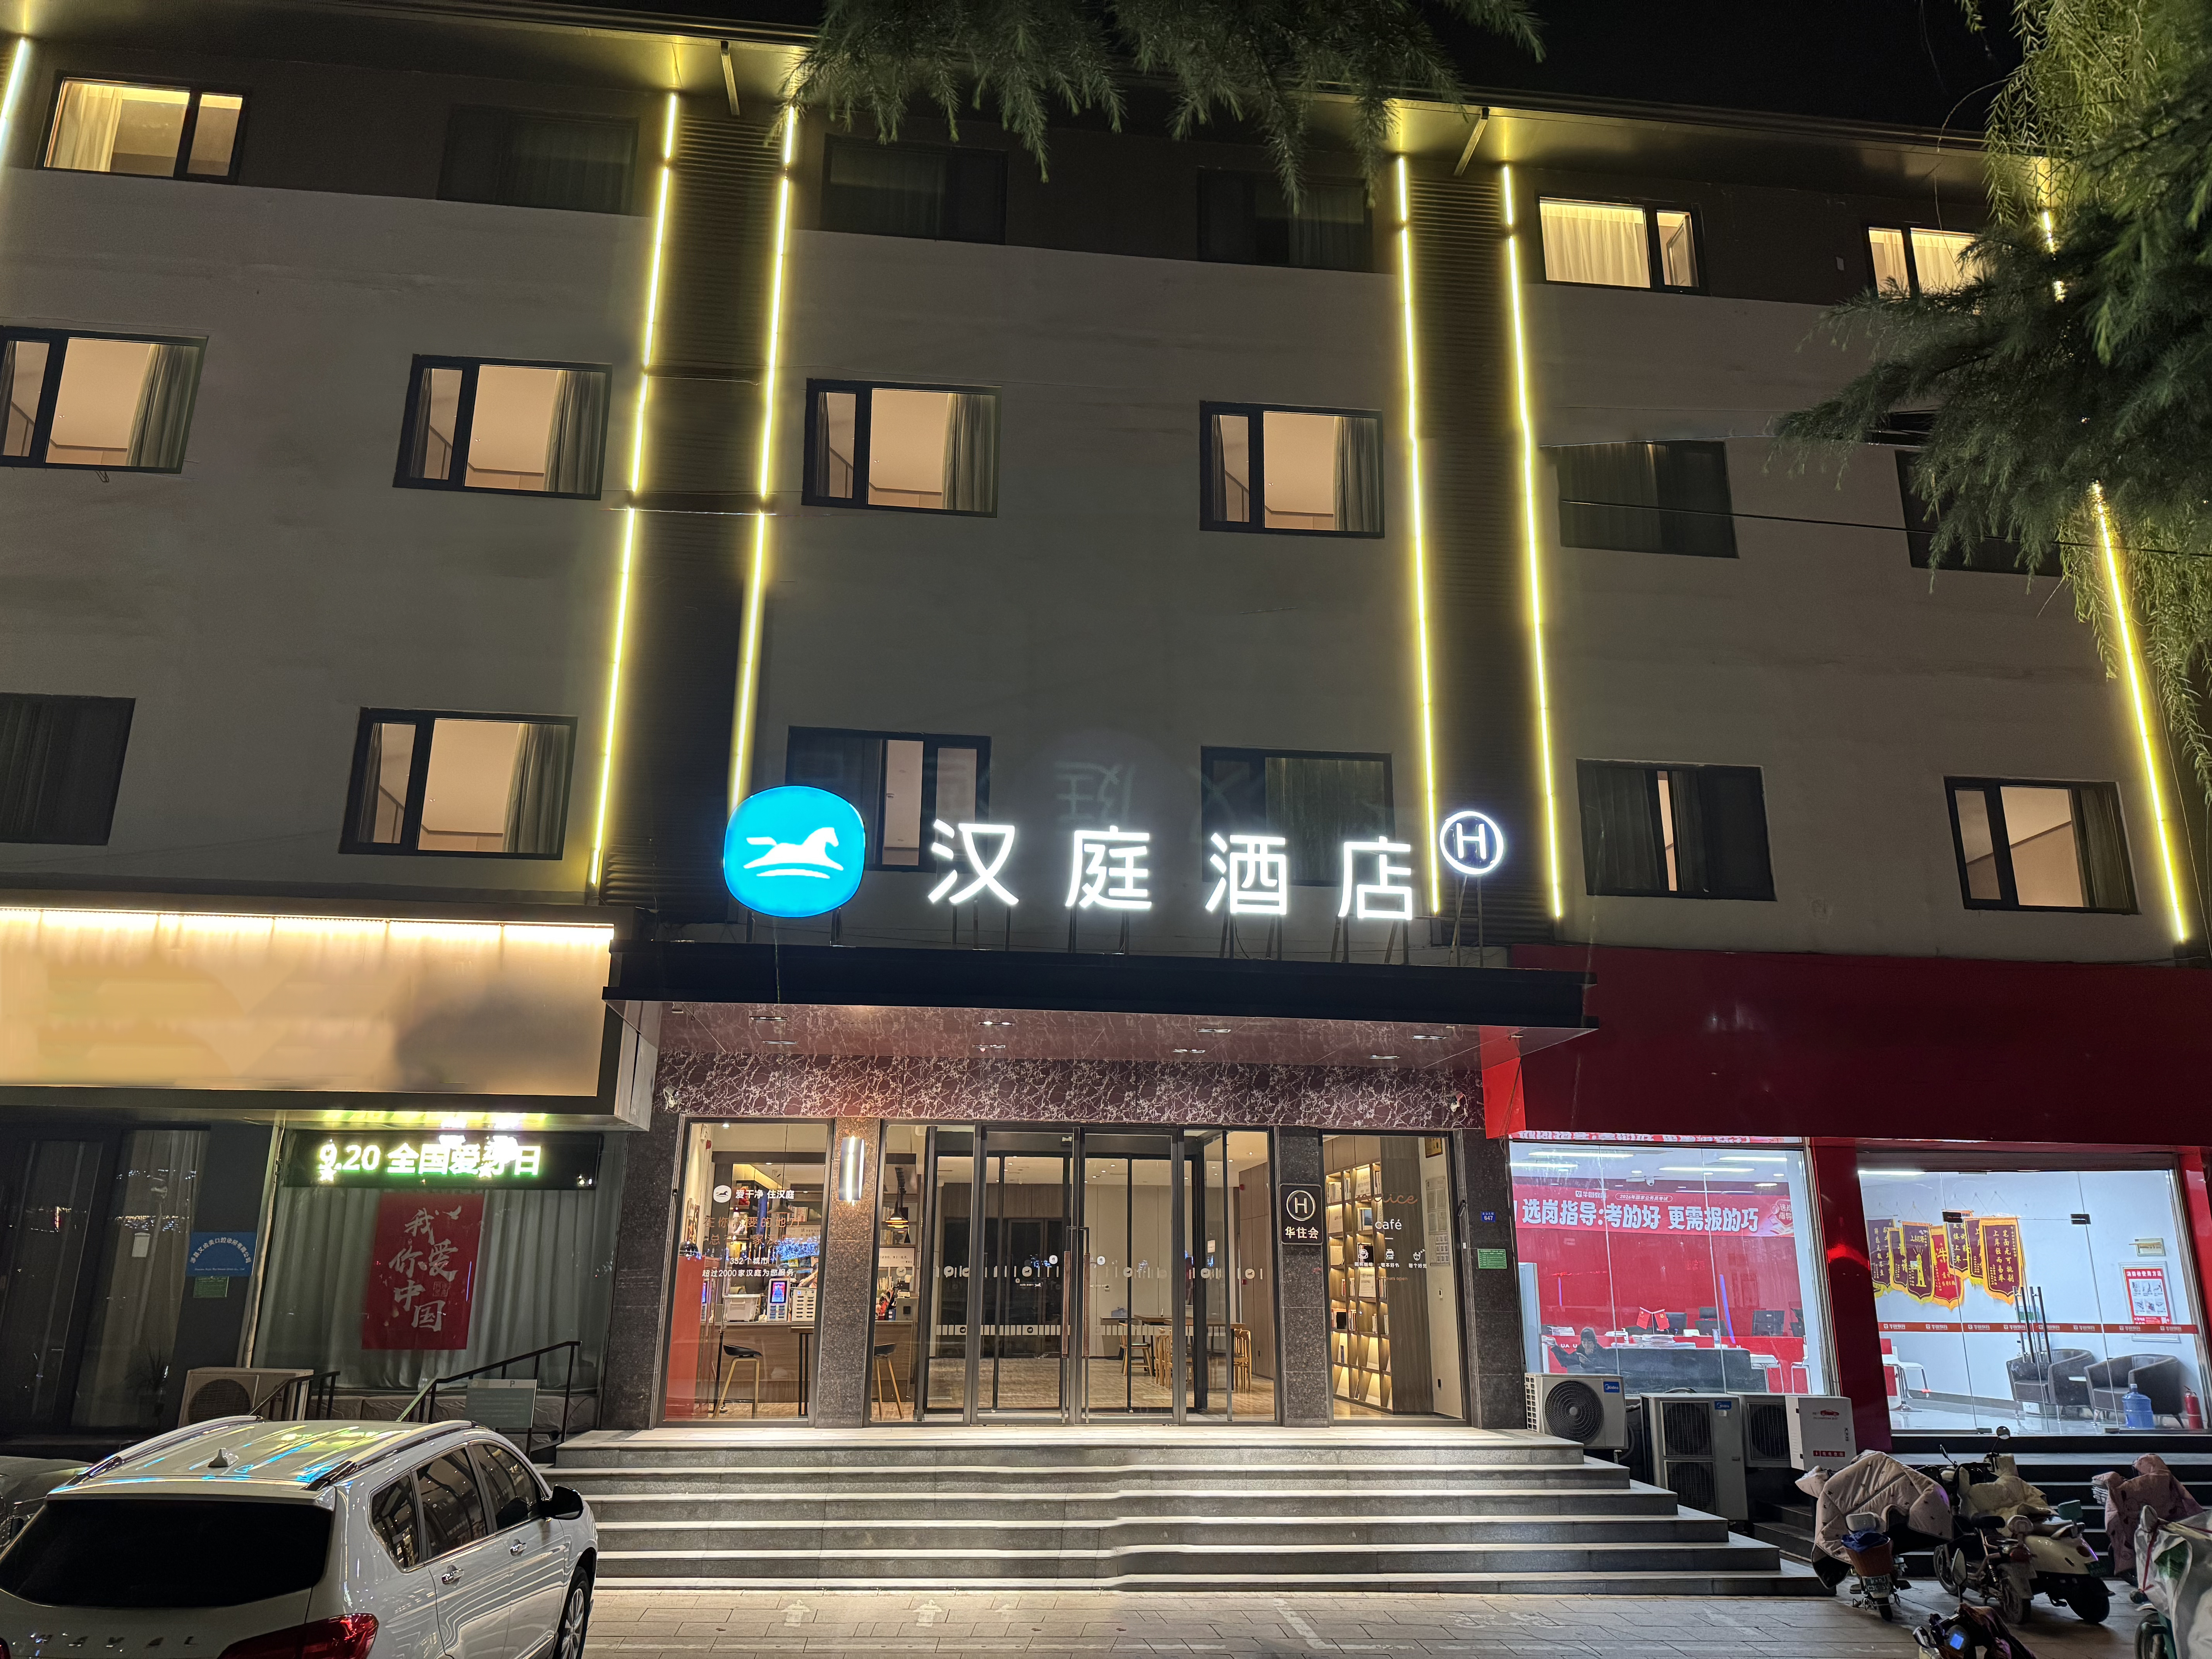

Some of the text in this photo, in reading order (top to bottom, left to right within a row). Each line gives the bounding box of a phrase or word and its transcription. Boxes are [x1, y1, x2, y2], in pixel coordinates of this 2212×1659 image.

[927, 818, 1414, 921] 汉庭酒店
[319, 1143, 381, 1171] 9.20
[735, 1189, 795, 1199] 爱干净 住汉庭
[1375, 1219, 1402, 1230] café
[1668, 1206, 1759, 1232] 更需报的巧
[1285, 1226, 1319, 1239] 华住会
[702, 1269, 794, 1277] 超过2000家汉庭为您服务
